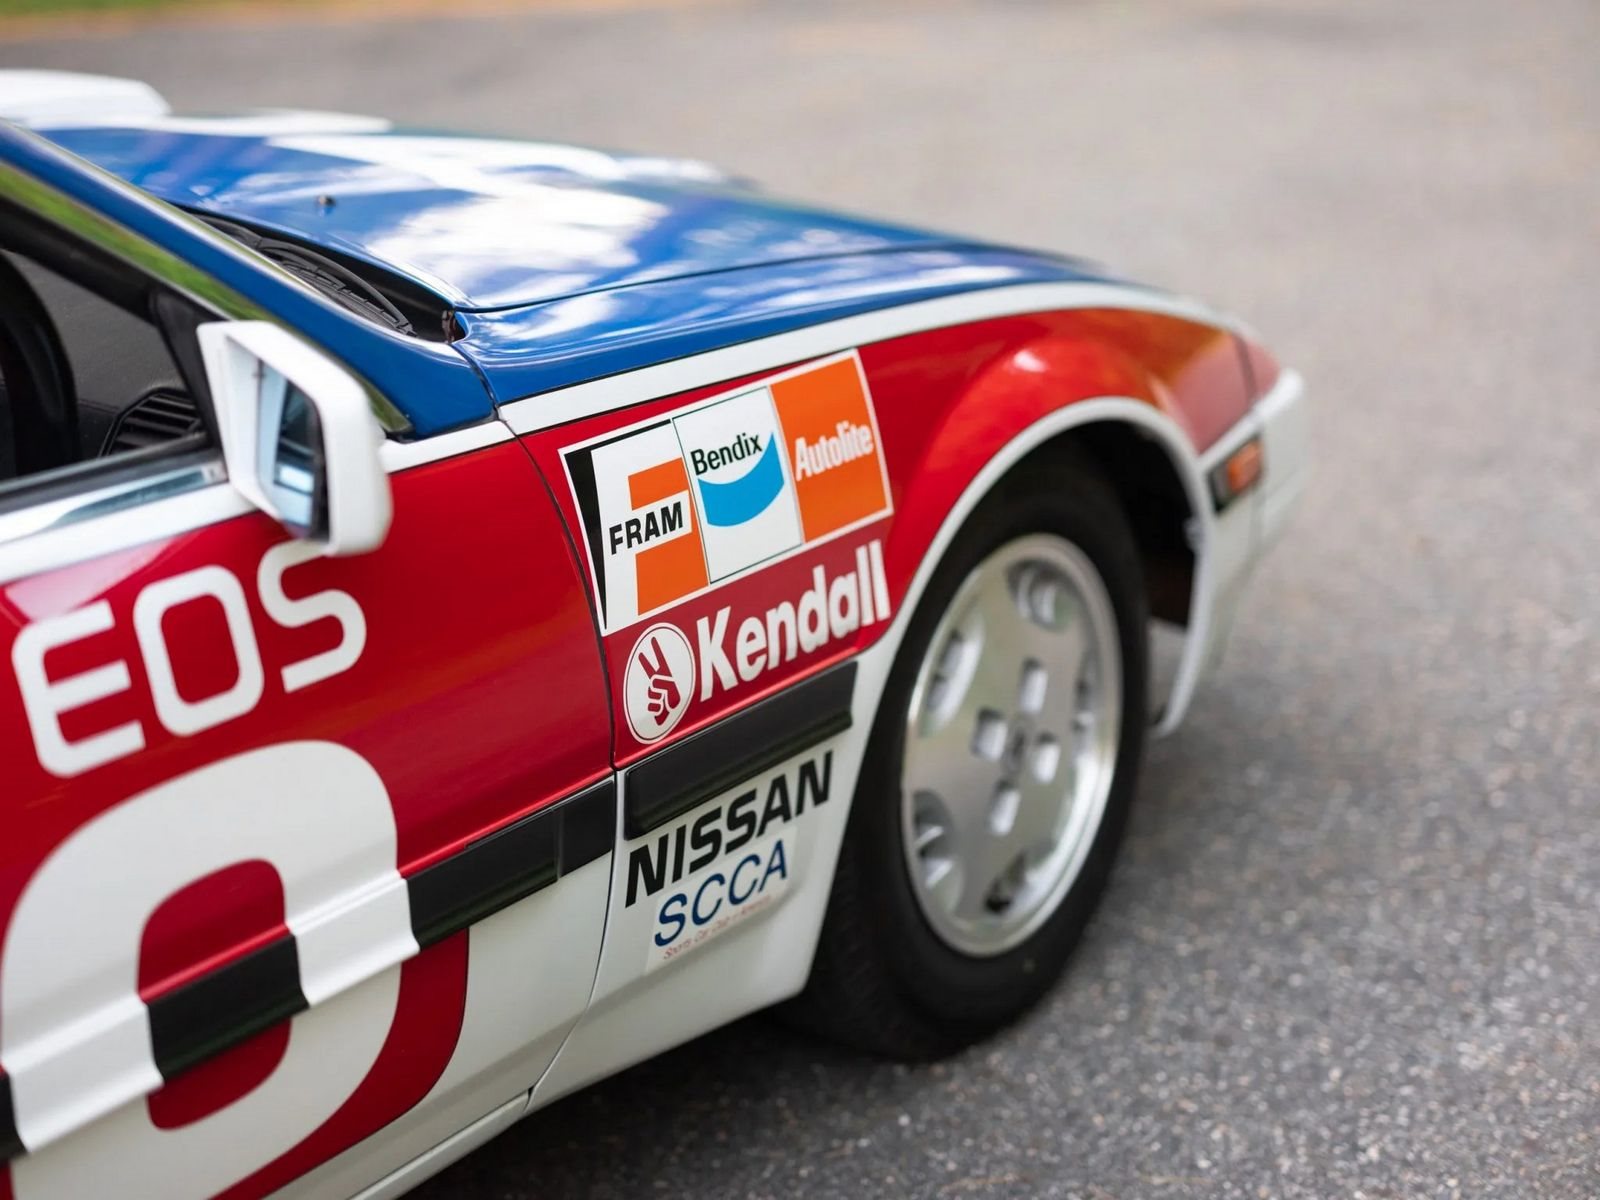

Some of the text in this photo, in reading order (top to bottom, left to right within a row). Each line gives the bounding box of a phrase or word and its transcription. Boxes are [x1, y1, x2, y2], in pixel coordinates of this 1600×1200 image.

[690, 432, 763, 476] Bendix
[795, 421, 875, 482] Autolite
[608, 501, 684, 556] FRAM
[12, 540, 367, 779] EOS
[697, 539, 891, 703] Kendall
[625, 749, 833, 909] NISSAN
[654, 839, 788, 947] SCCA
